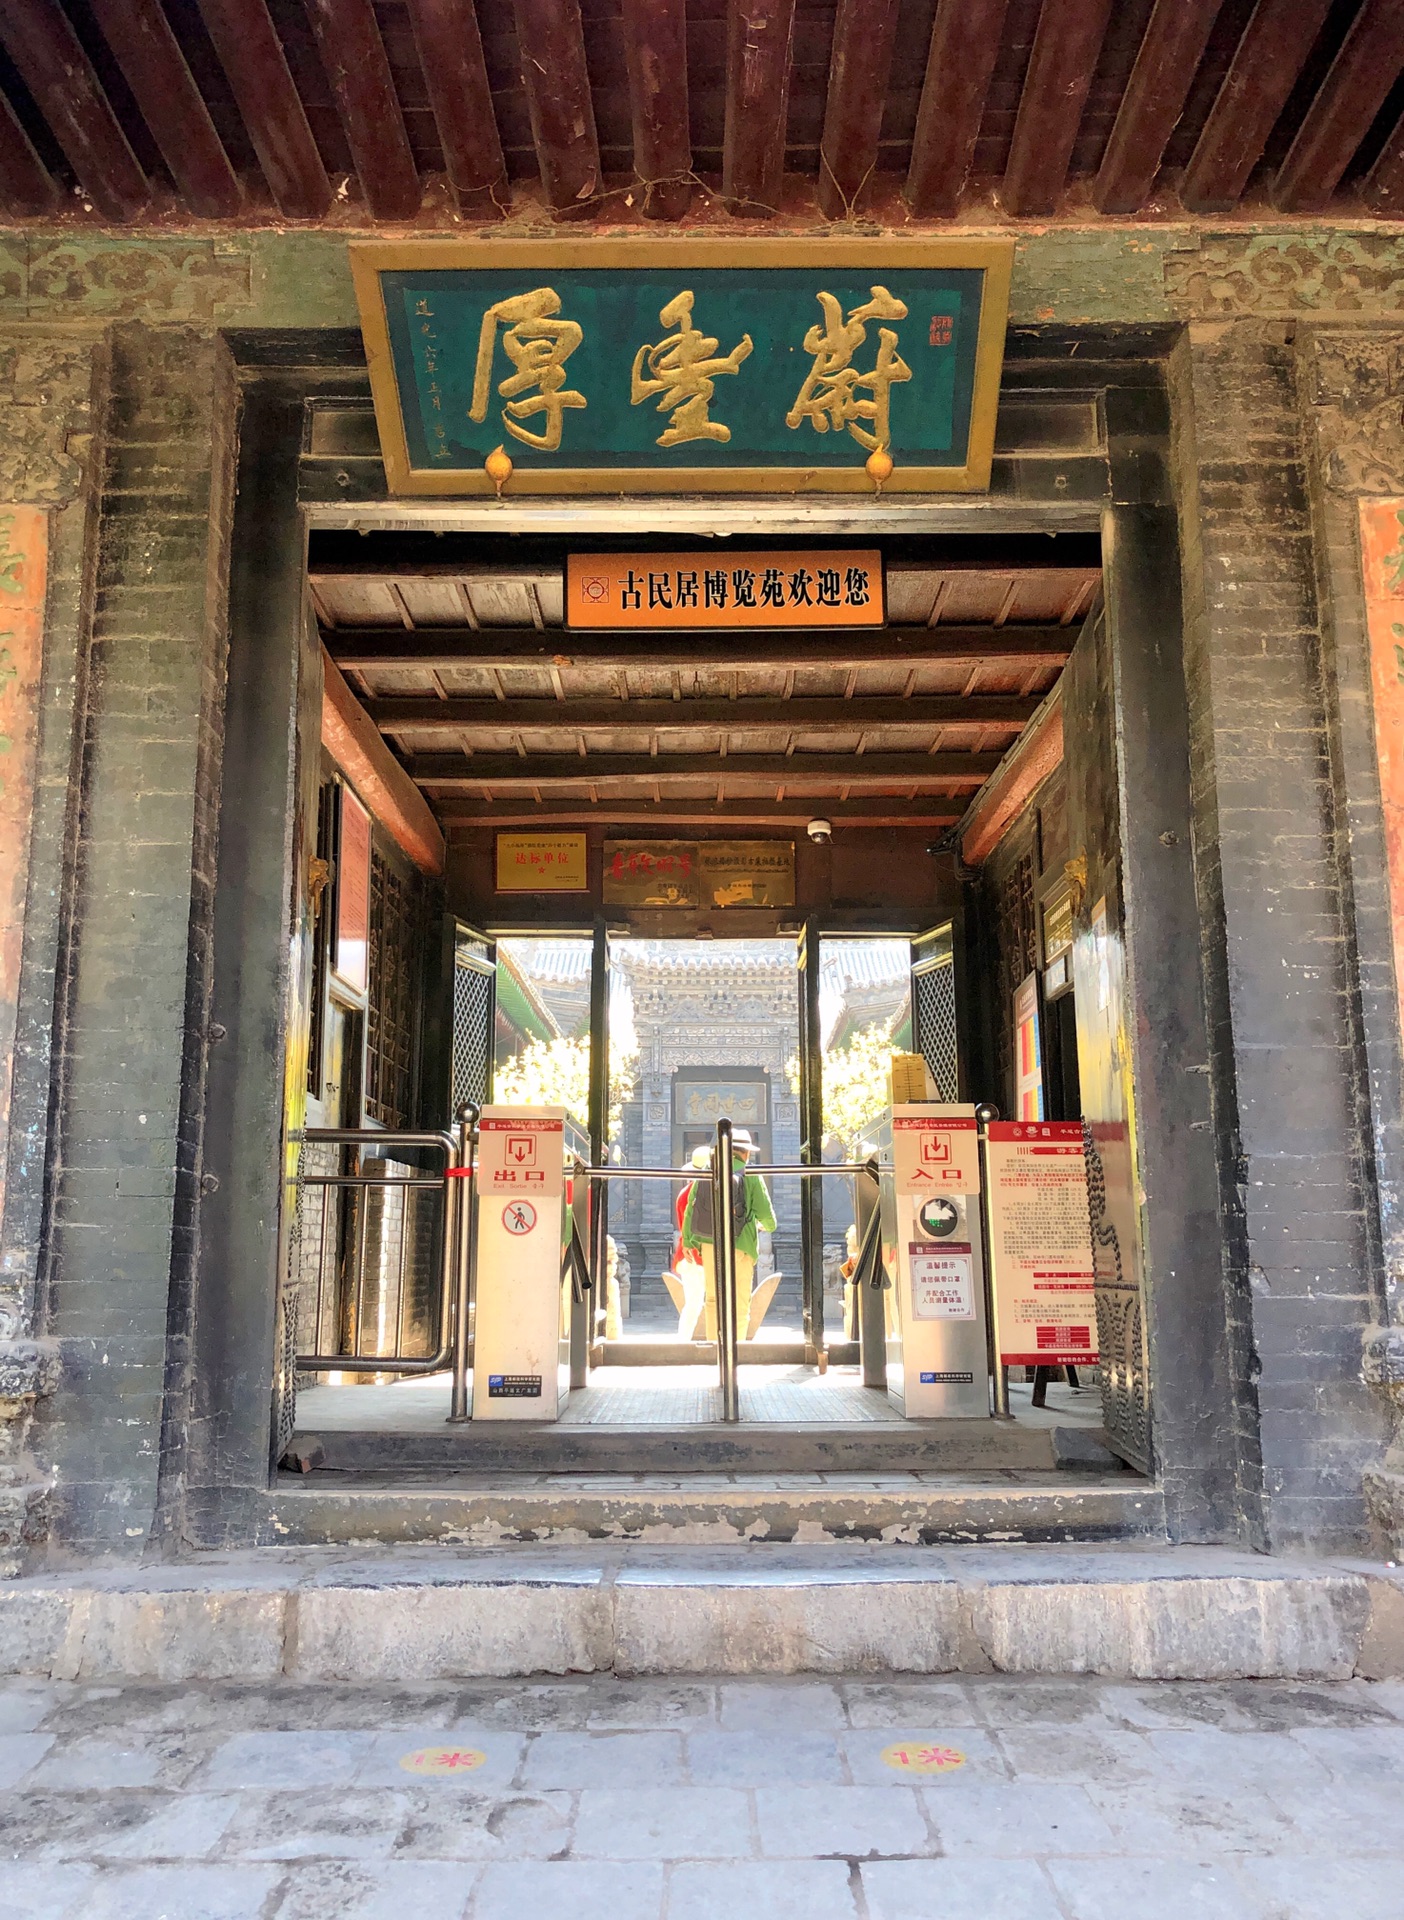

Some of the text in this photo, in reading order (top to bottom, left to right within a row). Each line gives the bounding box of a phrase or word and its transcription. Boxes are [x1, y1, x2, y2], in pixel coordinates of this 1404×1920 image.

[617, 567, 871, 611] 古民居博览苑欢迎您
[515, 851, 569, 865] 达标单位
[494, 1170, 545, 1181] 出口
[911, 1168, 962, 1180] 入口
[926, 1261, 957, 1270] 温馨提示
[926, 1289, 959, 1297] 并配合工作
[893, 1747, 962, 1766] 1米
